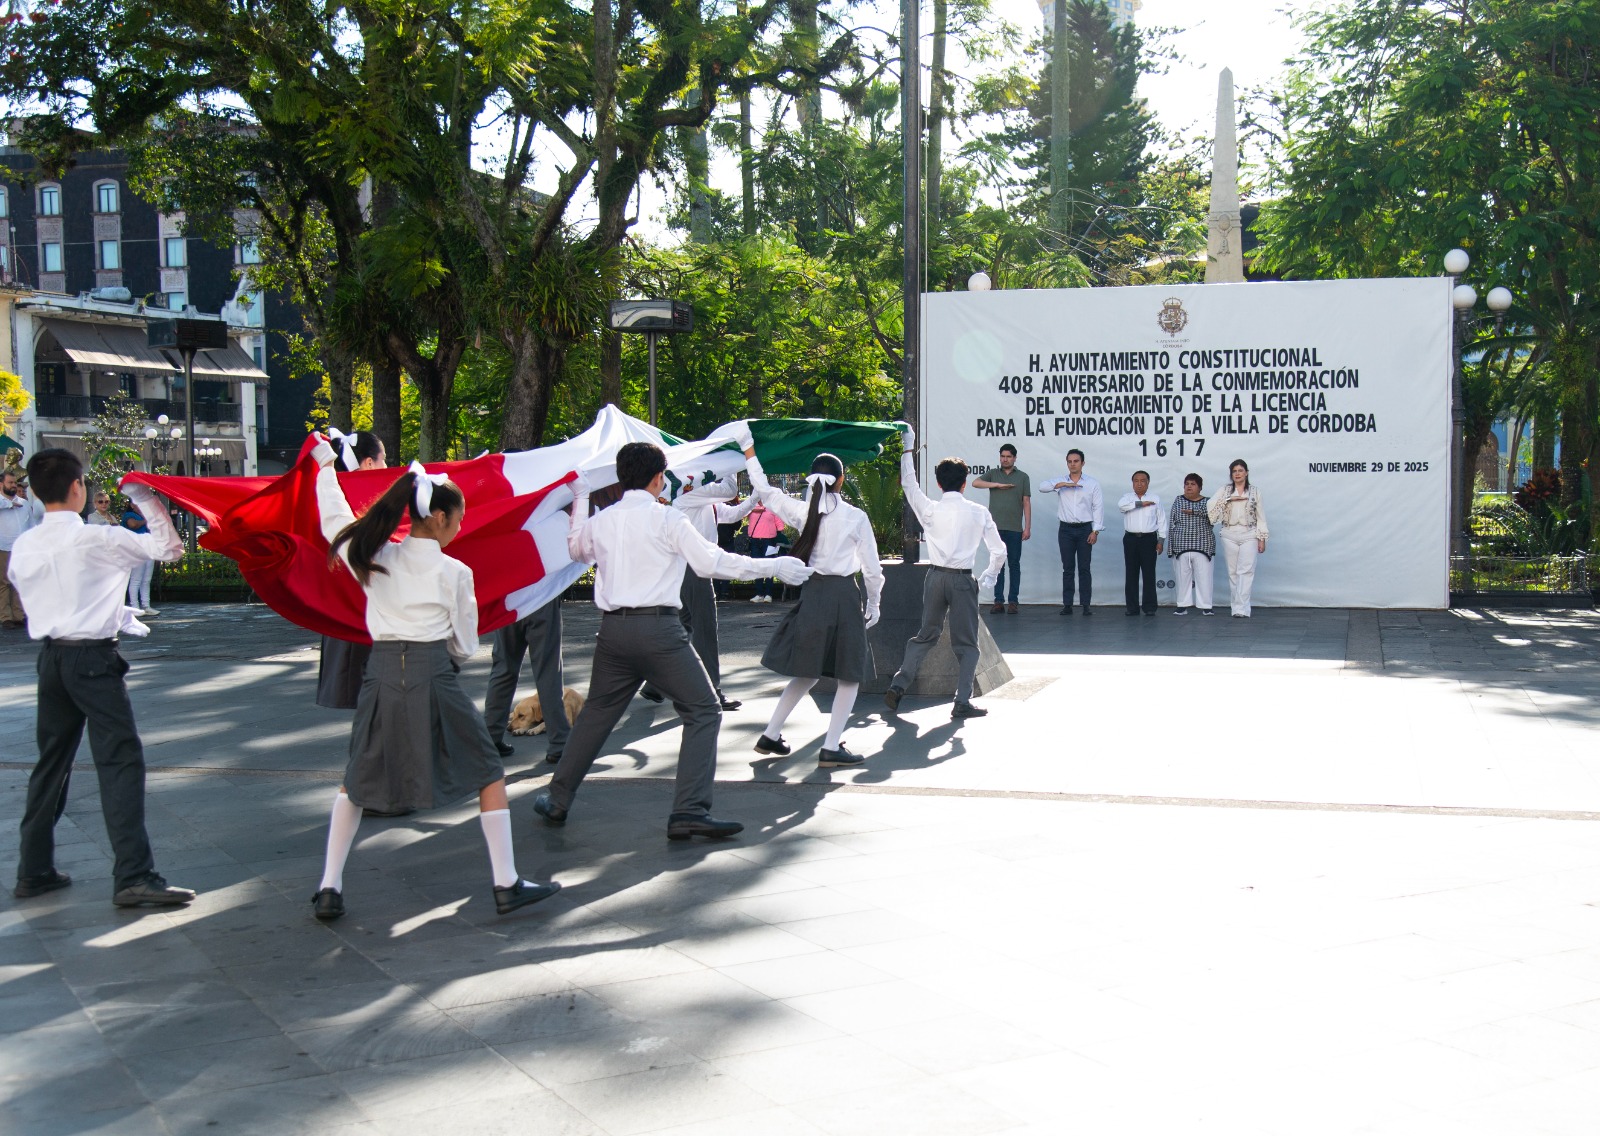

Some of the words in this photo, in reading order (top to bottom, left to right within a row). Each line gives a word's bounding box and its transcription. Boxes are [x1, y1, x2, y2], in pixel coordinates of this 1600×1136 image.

[1029, 353, 1044, 373] H.
[1049, 351, 1170, 372] AYUNTAMIENTO
[1179, 348, 1323, 370] CONSTITUCIONAL
[998, 375, 1034, 395] 408
[1041, 373, 1145, 394] ANIVERSARIO
[1153, 373, 1174, 393] DE
[1181, 372, 1204, 392] LA
[1211, 366, 1359, 391] CONMEMORACIÓN
[1025, 396, 1055, 416] DEL
[1061, 394, 1184, 415] OTORGAMIENTO
[1192, 394, 1212, 413] DE
[1220, 393, 1243, 413] LA
[1251, 392, 1327, 412] LICENCIA
[976, 418, 1017, 437] PARA
[1025, 418, 1046, 437] LA
[1054, 413, 1145, 436] FUNDACIÓN
[1154, 416, 1174, 435] DE
[1181, 415, 1203, 435] LA
[1211, 415, 1260, 434] VILLA
[1268, 414, 1289, 434] DE
[1297, 411, 1377, 434] CÓRDOBA
[1308, 462, 1367, 473] NOVIEMBRE
[1371, 461, 1384, 473] 29
[1387, 461, 1401, 472] DE
[1404, 461, 1429, 472] 2025
